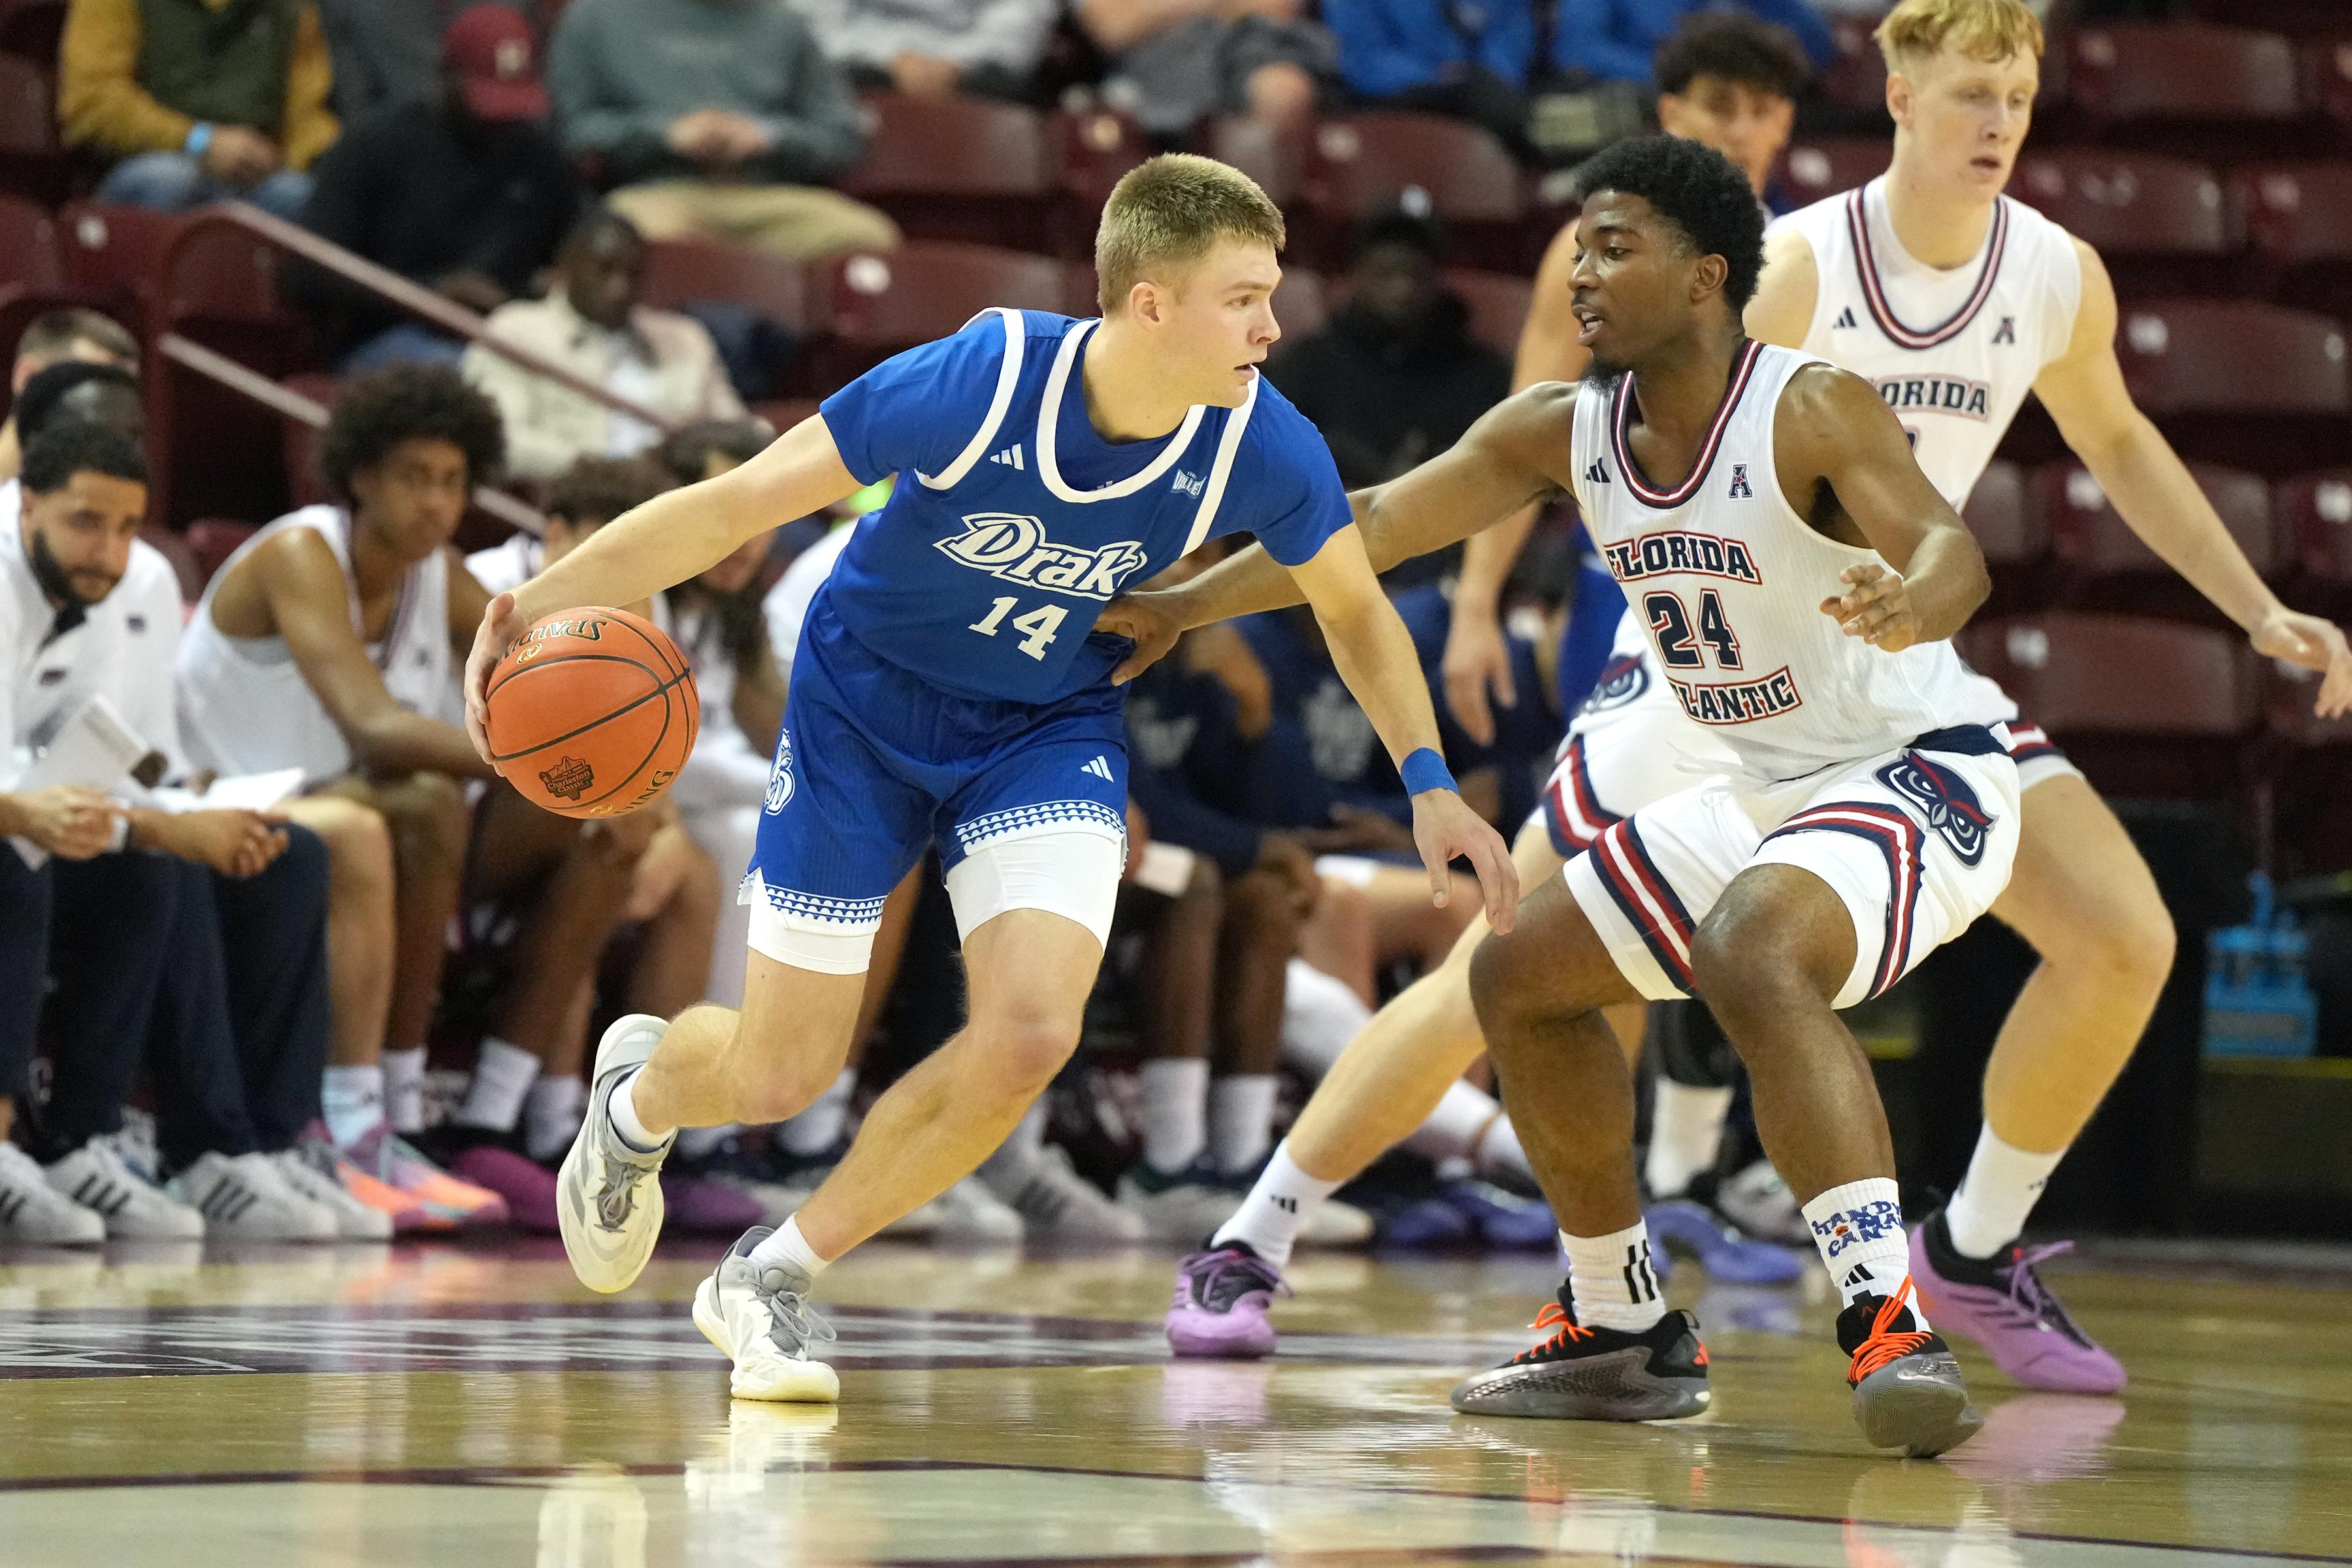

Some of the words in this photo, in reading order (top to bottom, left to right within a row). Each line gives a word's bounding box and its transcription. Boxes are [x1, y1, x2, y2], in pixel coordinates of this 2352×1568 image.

[1874, 375, 1989, 419] ORIDA
[1728, 465, 1752, 498] A
[934, 514, 1147, 600] Drak
[968, 596, 1069, 661] 14
[1643, 589, 1743, 670] 24
[1668, 668, 1800, 724] LANTIC
